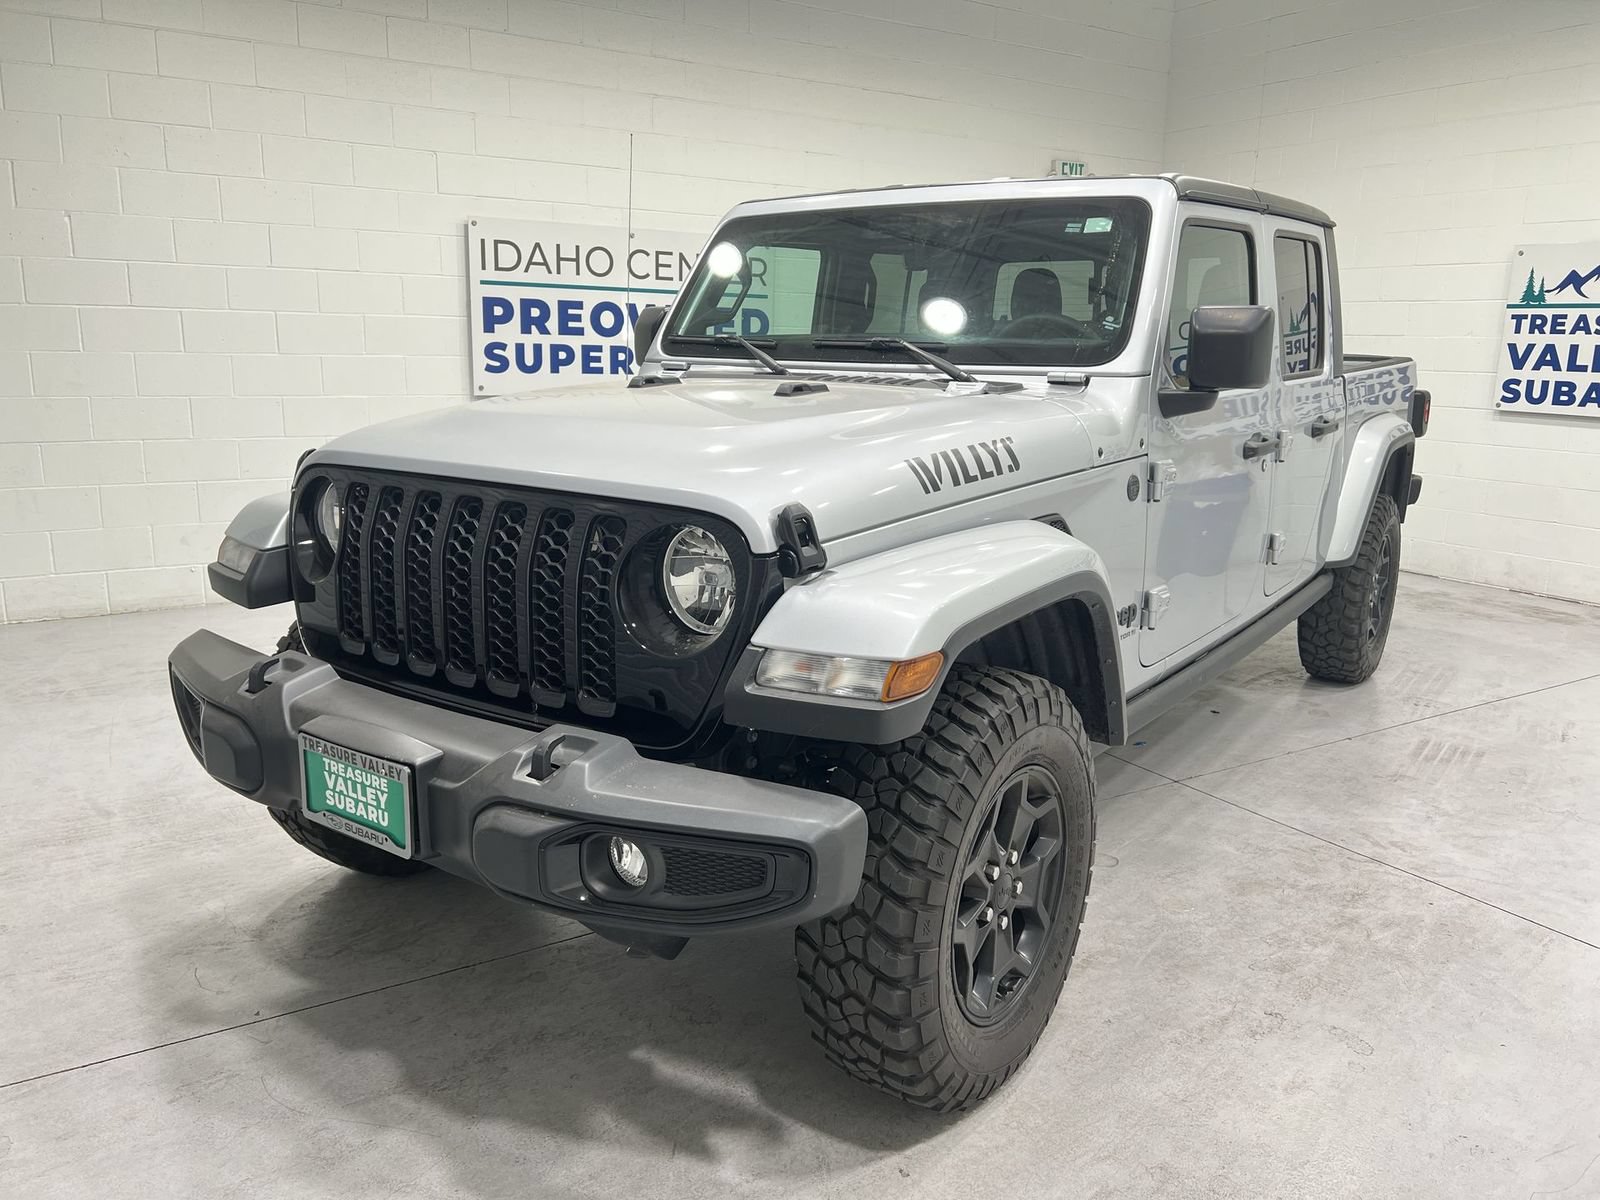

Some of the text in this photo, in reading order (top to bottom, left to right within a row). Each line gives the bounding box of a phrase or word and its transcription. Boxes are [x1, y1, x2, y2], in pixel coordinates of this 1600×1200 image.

[479, 238, 768, 287] IDAHO CENR
[481, 296, 770, 338] PREOED
[904, 436, 1020, 495] WILLYS
[302, 735, 402, 781] TREASURE VALLEY
[322, 758, 388, 792] TREASURE
[324, 771, 389, 809] VALLEY
[325, 789, 389, 827] SUBARU
[344, 822, 384, 845] SUBARU
